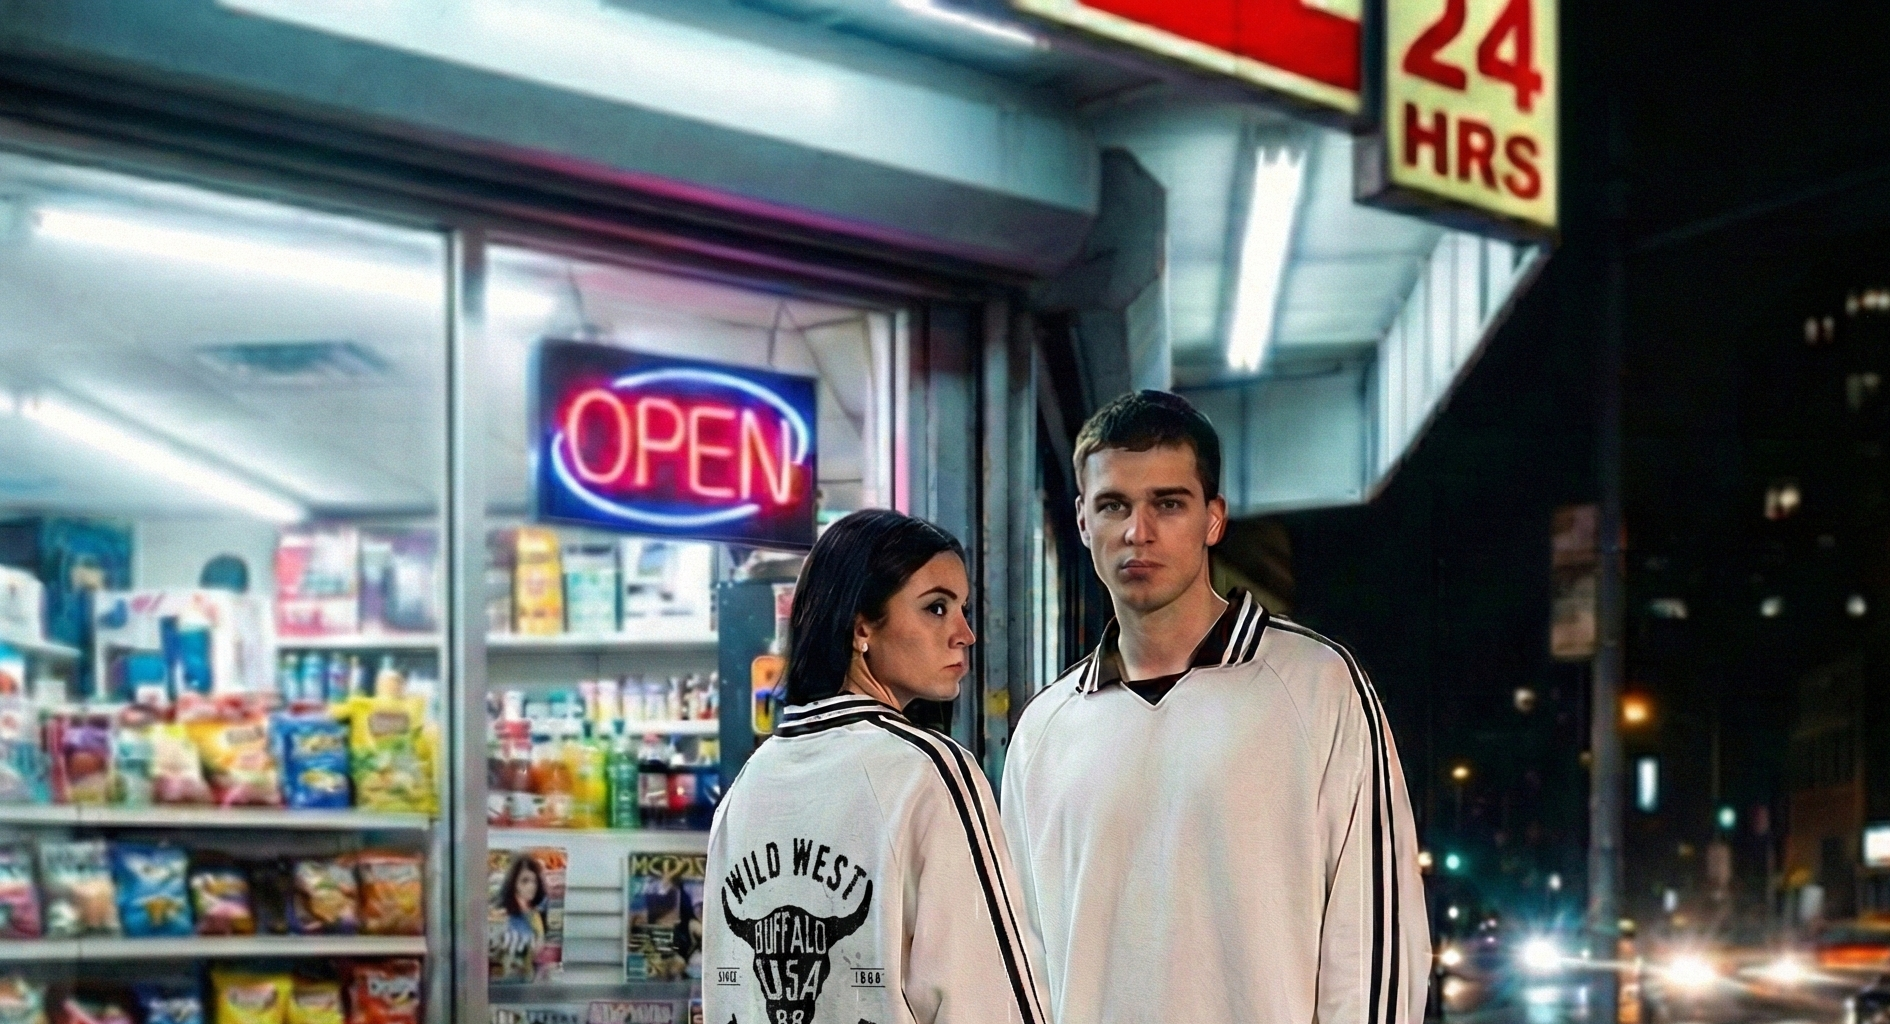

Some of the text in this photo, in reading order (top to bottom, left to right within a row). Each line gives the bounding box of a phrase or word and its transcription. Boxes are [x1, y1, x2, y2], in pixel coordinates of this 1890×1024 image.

[1401, 0, 1543, 113] 24
[1404, 103, 1541, 200] HRS
[566, 387, 793, 506] OPEN
[724, 838, 867, 905] WILD WEST
[754, 911, 828, 955] BUFFALO
[755, 958, 823, 1002] USA
